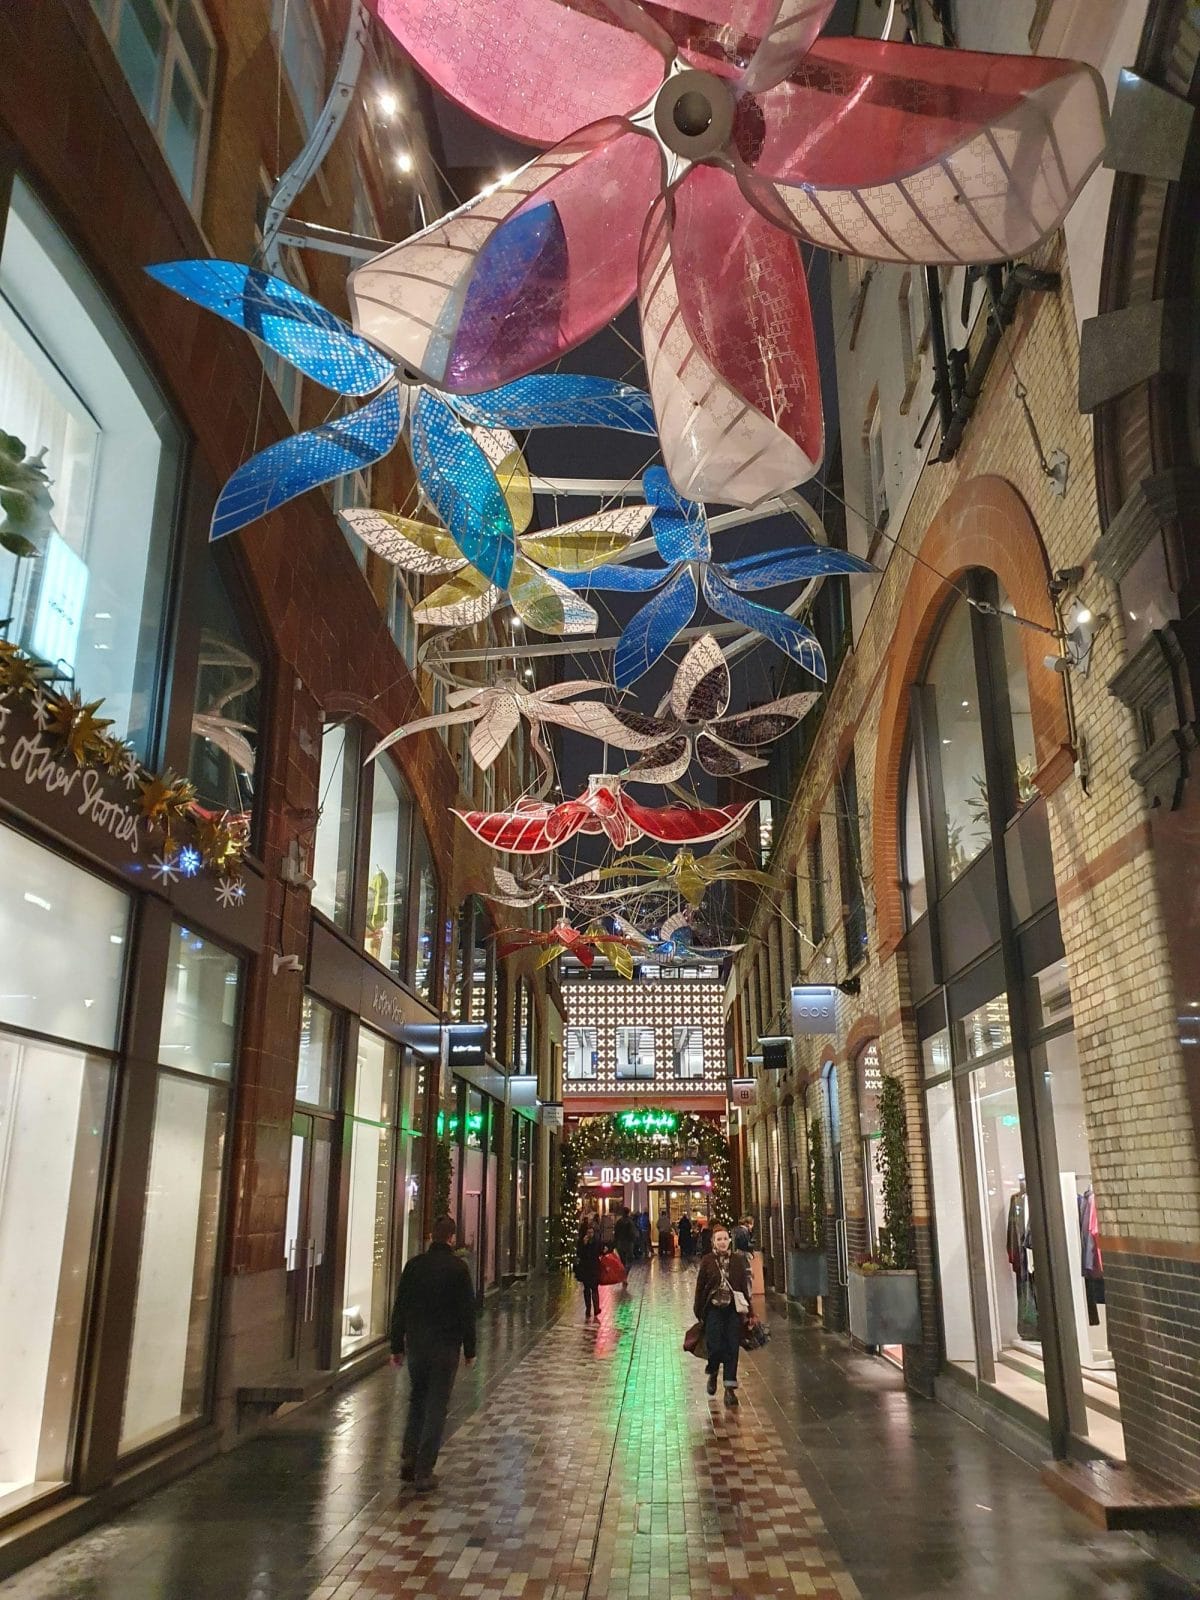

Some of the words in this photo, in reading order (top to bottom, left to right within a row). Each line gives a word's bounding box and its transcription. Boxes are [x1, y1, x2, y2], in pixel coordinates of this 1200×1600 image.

[77, 769, 140, 854] Stories
[799, 1006, 829, 1018] COS
[622, 1113, 641, 1128] The
[601, 1167, 671, 1183] MISCUSI
